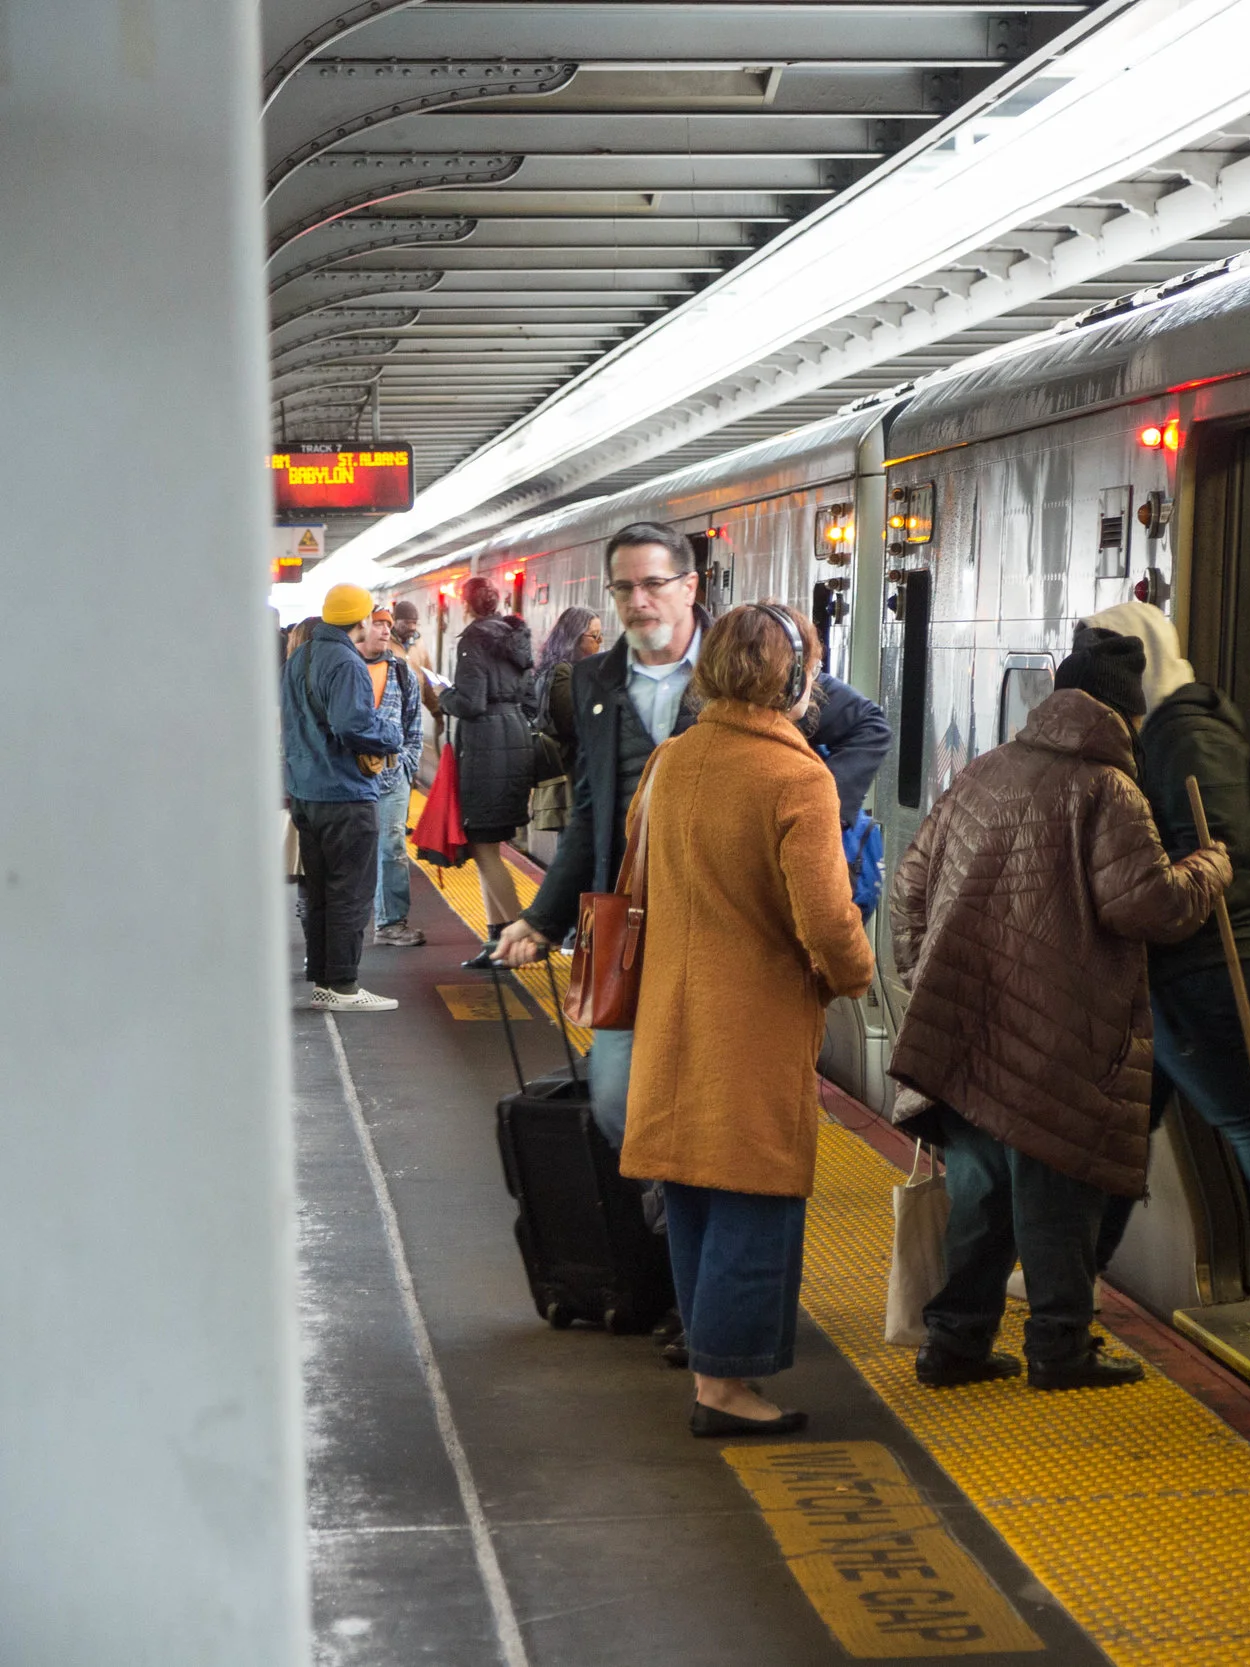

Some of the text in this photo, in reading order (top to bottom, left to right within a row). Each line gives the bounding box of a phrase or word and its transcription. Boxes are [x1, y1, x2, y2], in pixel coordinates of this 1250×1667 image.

[301, 444, 342, 453] TRACK 7
[337, 451, 409, 467] ST. ALBANS
[289, 466, 355, 485] BABYLON
[766, 1449, 898, 1525] WATCH
[820, 1534, 939, 1582] THE
[858, 1588, 986, 1643] GAP
